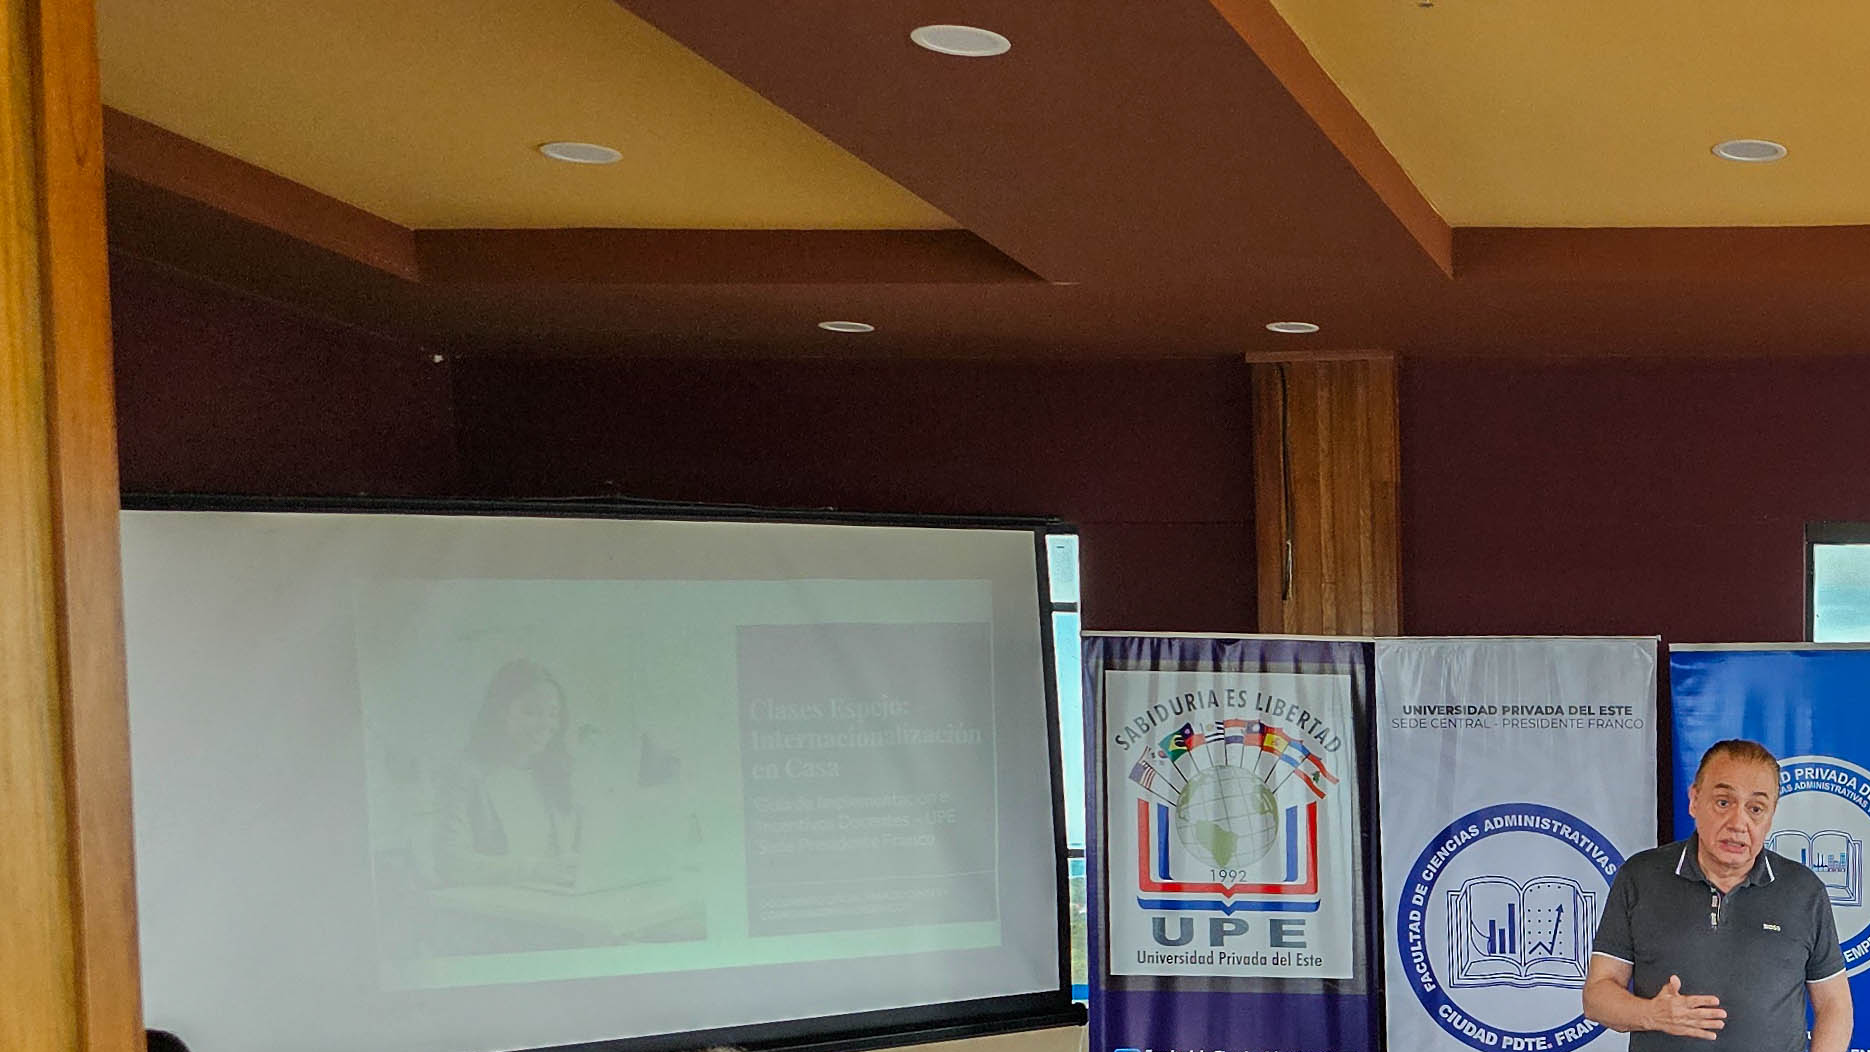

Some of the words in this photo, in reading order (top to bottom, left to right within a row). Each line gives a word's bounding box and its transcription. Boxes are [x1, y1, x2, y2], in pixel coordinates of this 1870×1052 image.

[1115, 690, 1219, 751] SABIDURIA
[1227, 689, 1247, 708] ES
[1255, 692, 1342, 753] LIBERTAD
[1391, 718, 1428, 729] SEDE
[1430, 718, 1490, 729] CENTRAL
[1502, 718, 1584, 729] PRESIDENTE
[1587, 718, 1644, 729] FRANCO
[1403, 705, 1498, 715] UNIVERSIDAD
[1502, 705, 1564, 715] PRIVADA
[1568, 706, 1595, 715] DEL
[1599, 706, 1633, 716] ESTE
[1794, 767, 1857, 790] PRIVADA
[1794, 781, 1868, 809] ADMINISTRATIVAS
[1421, 825, 1480, 881] CIENCIAS
[1484, 814, 1618, 876] ADMINISTRATIVAS
[1209, 868, 1247, 883] 1992
[1412, 884, 1428, 909] DE
[1152, 917, 1307, 948] UPE
[1137, 949, 1214, 966] Universidad
[1219, 950, 1267, 967] Privada
[1272, 951, 1291, 967] del
[1296, 953, 1322, 967] Este
[1408, 910, 1436, 993] FACULTAD
[1438, 1004, 1499, 1046] CIUDAD
[1501, 1035, 1553, 1051] PDTE.
[1554, 1018, 1599, 1047] FRAN
